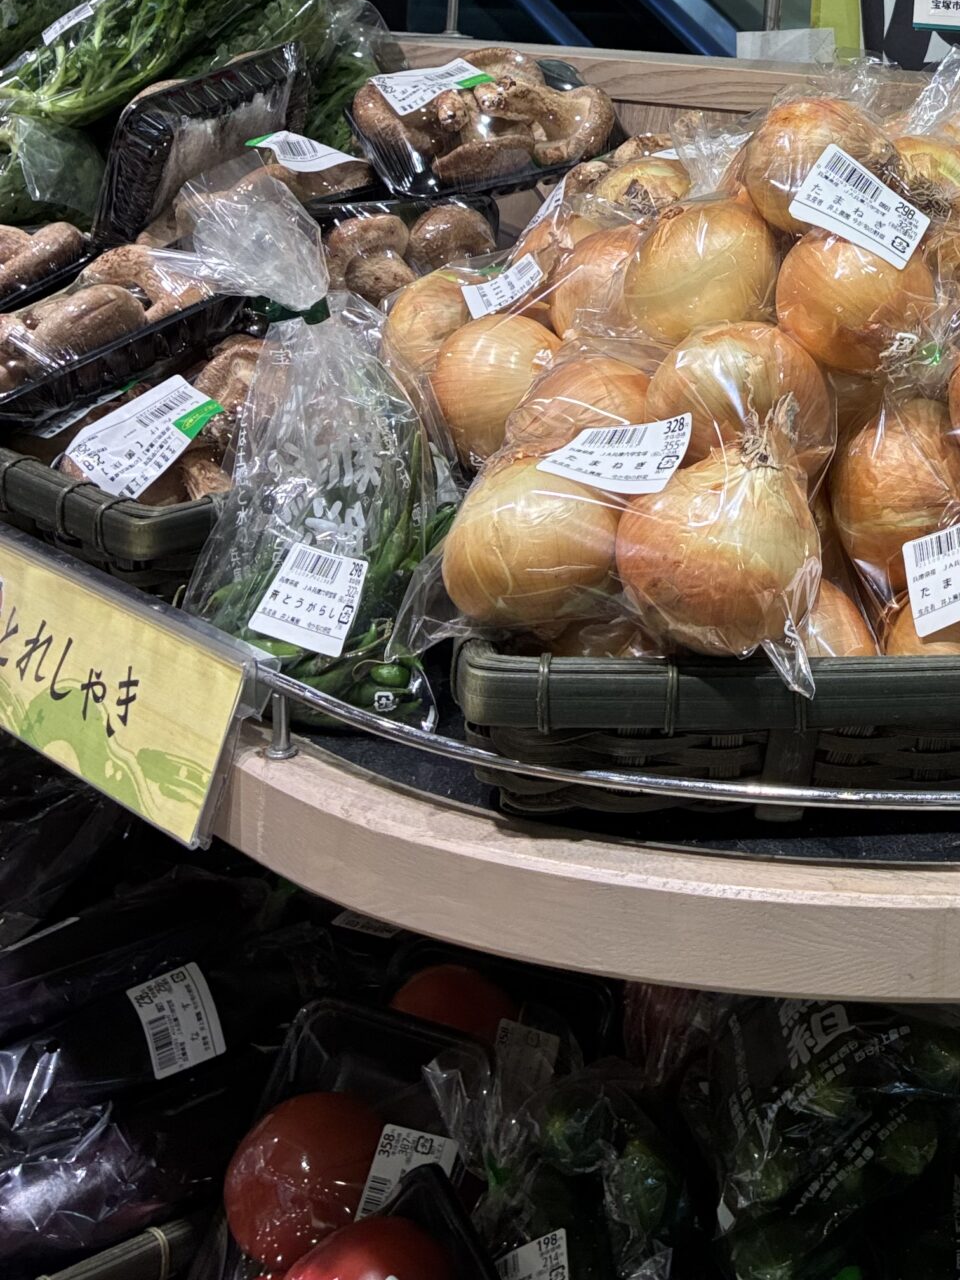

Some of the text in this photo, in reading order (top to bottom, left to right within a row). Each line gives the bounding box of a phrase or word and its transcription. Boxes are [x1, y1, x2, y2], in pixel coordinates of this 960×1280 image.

[810, 183, 887, 229] たまねぎ
[268, 589, 336, 620] 青とうがらし
[537, 1233, 557, 1252] 198
